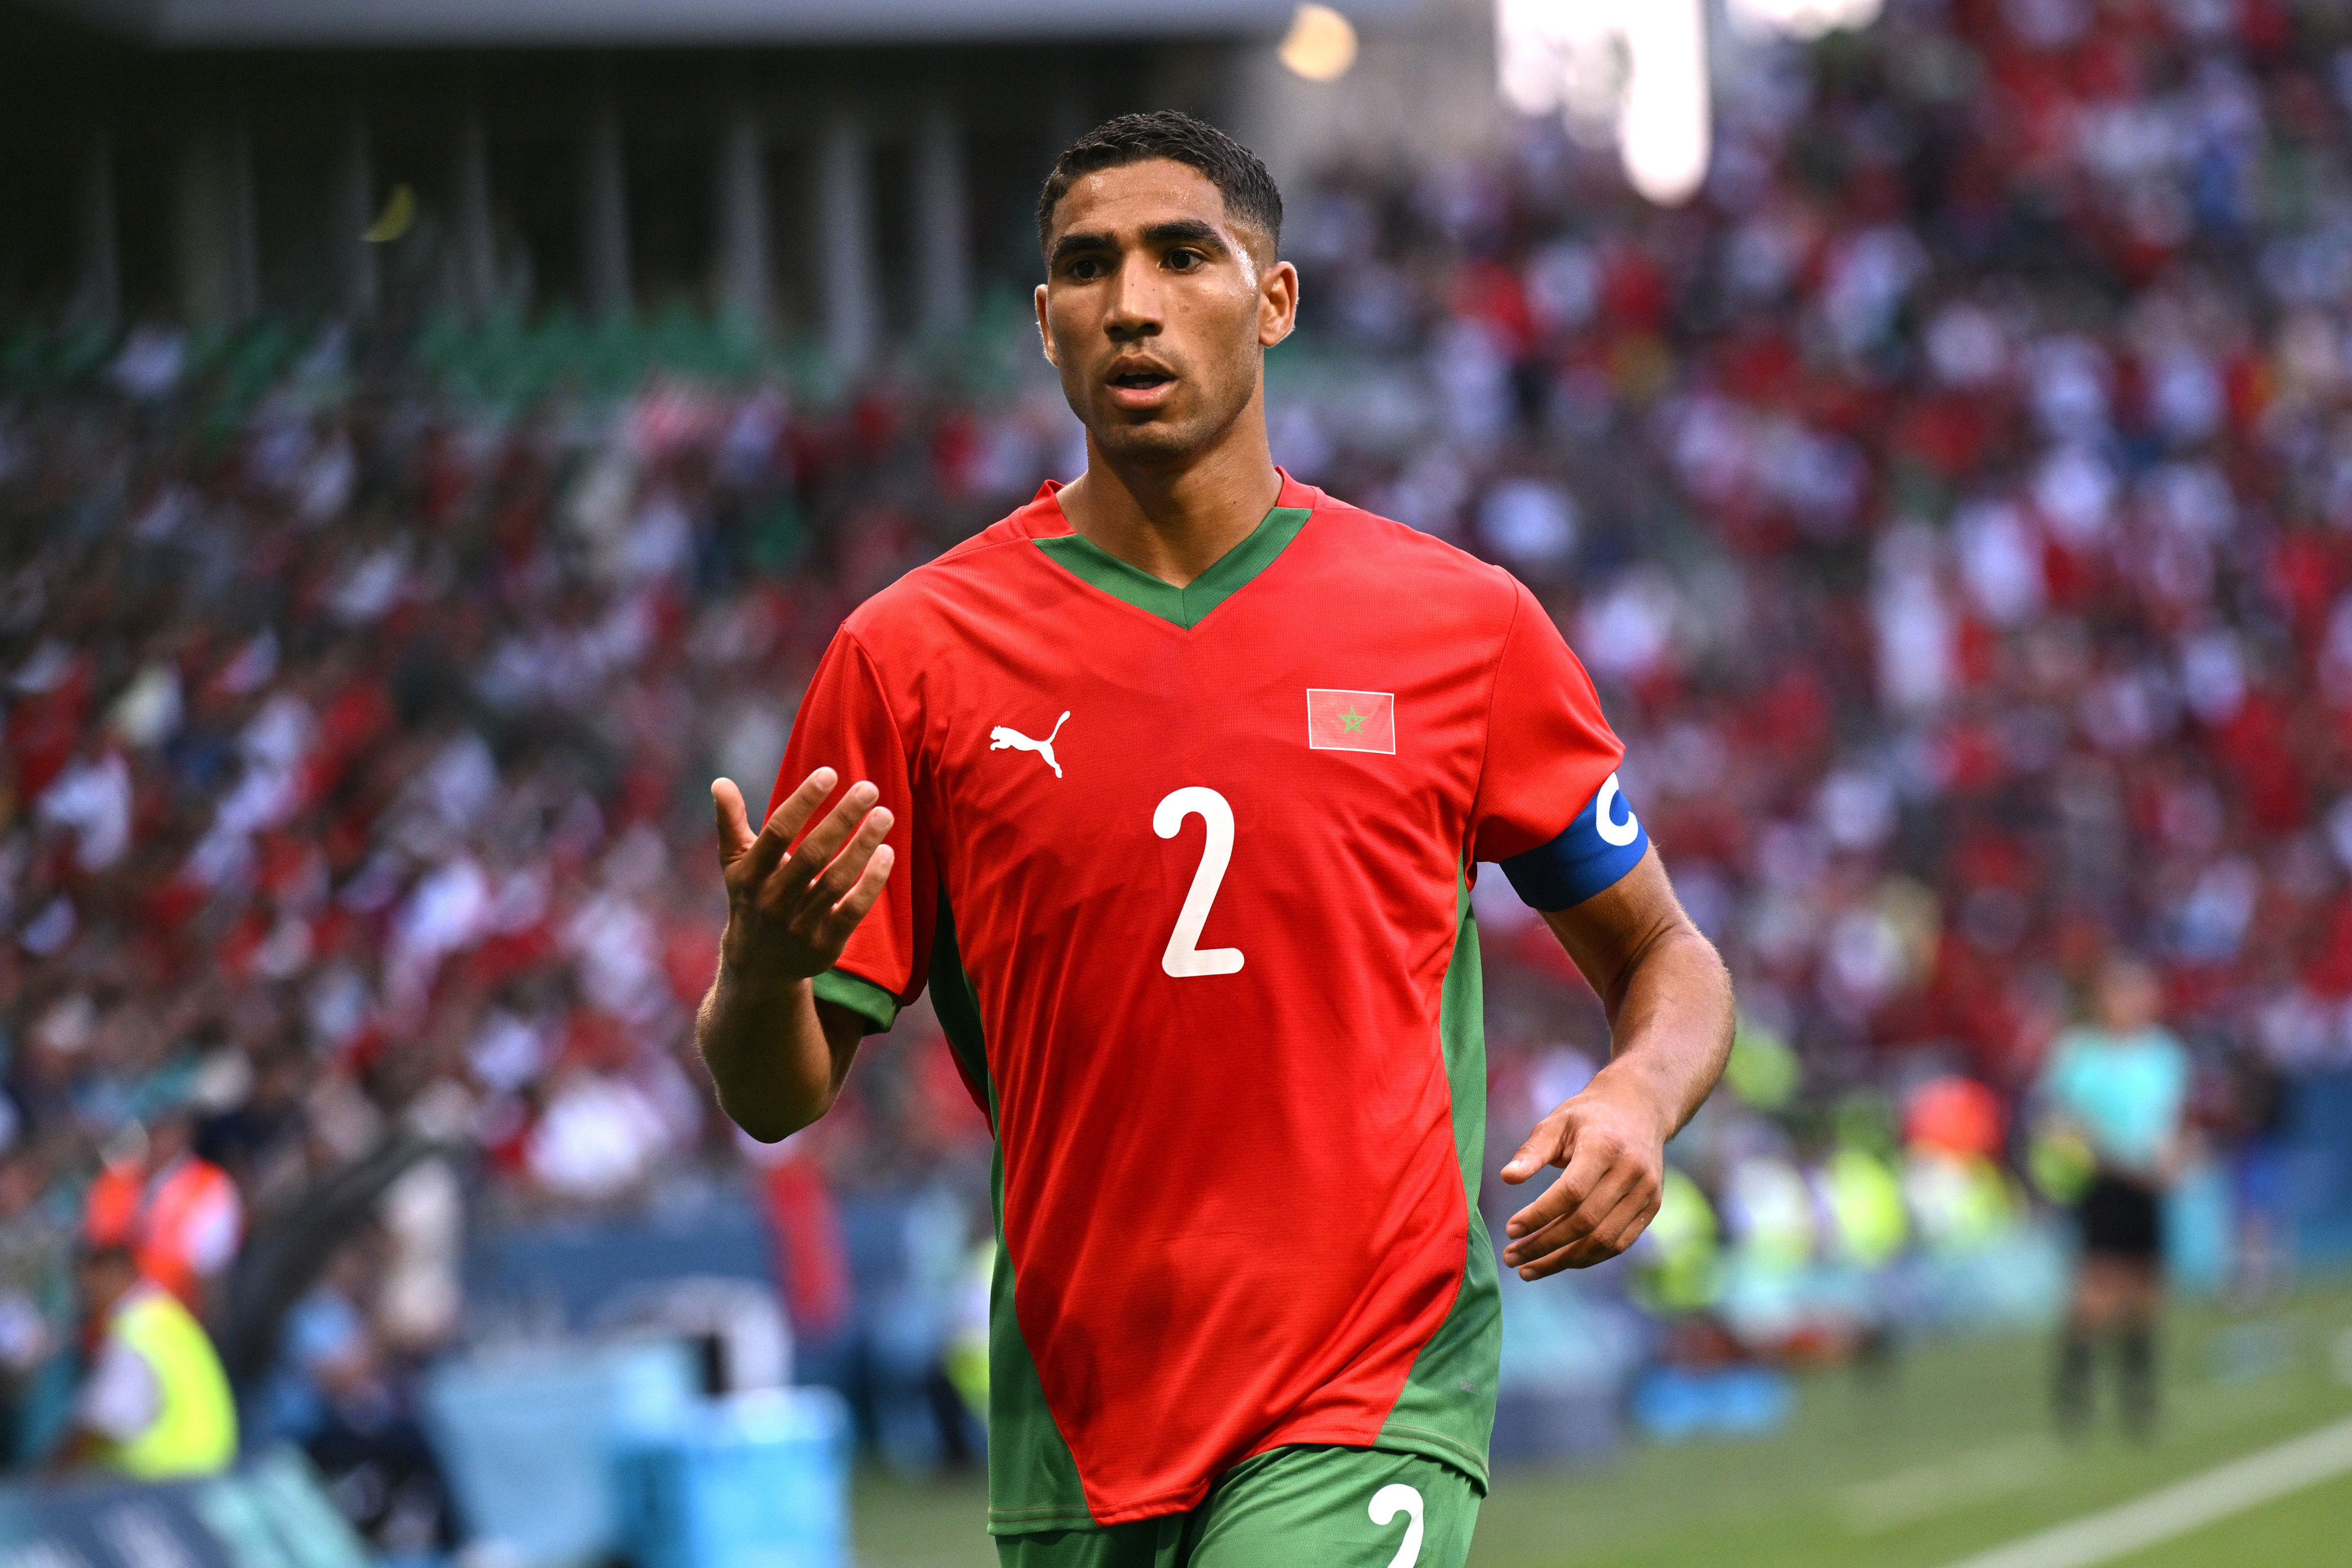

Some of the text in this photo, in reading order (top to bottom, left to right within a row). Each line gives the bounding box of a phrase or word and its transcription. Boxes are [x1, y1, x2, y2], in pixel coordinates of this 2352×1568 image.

[1596, 772, 1639, 846] C
[1153, 786, 1245, 977] 2
[1368, 1484, 1424, 1568] 2
